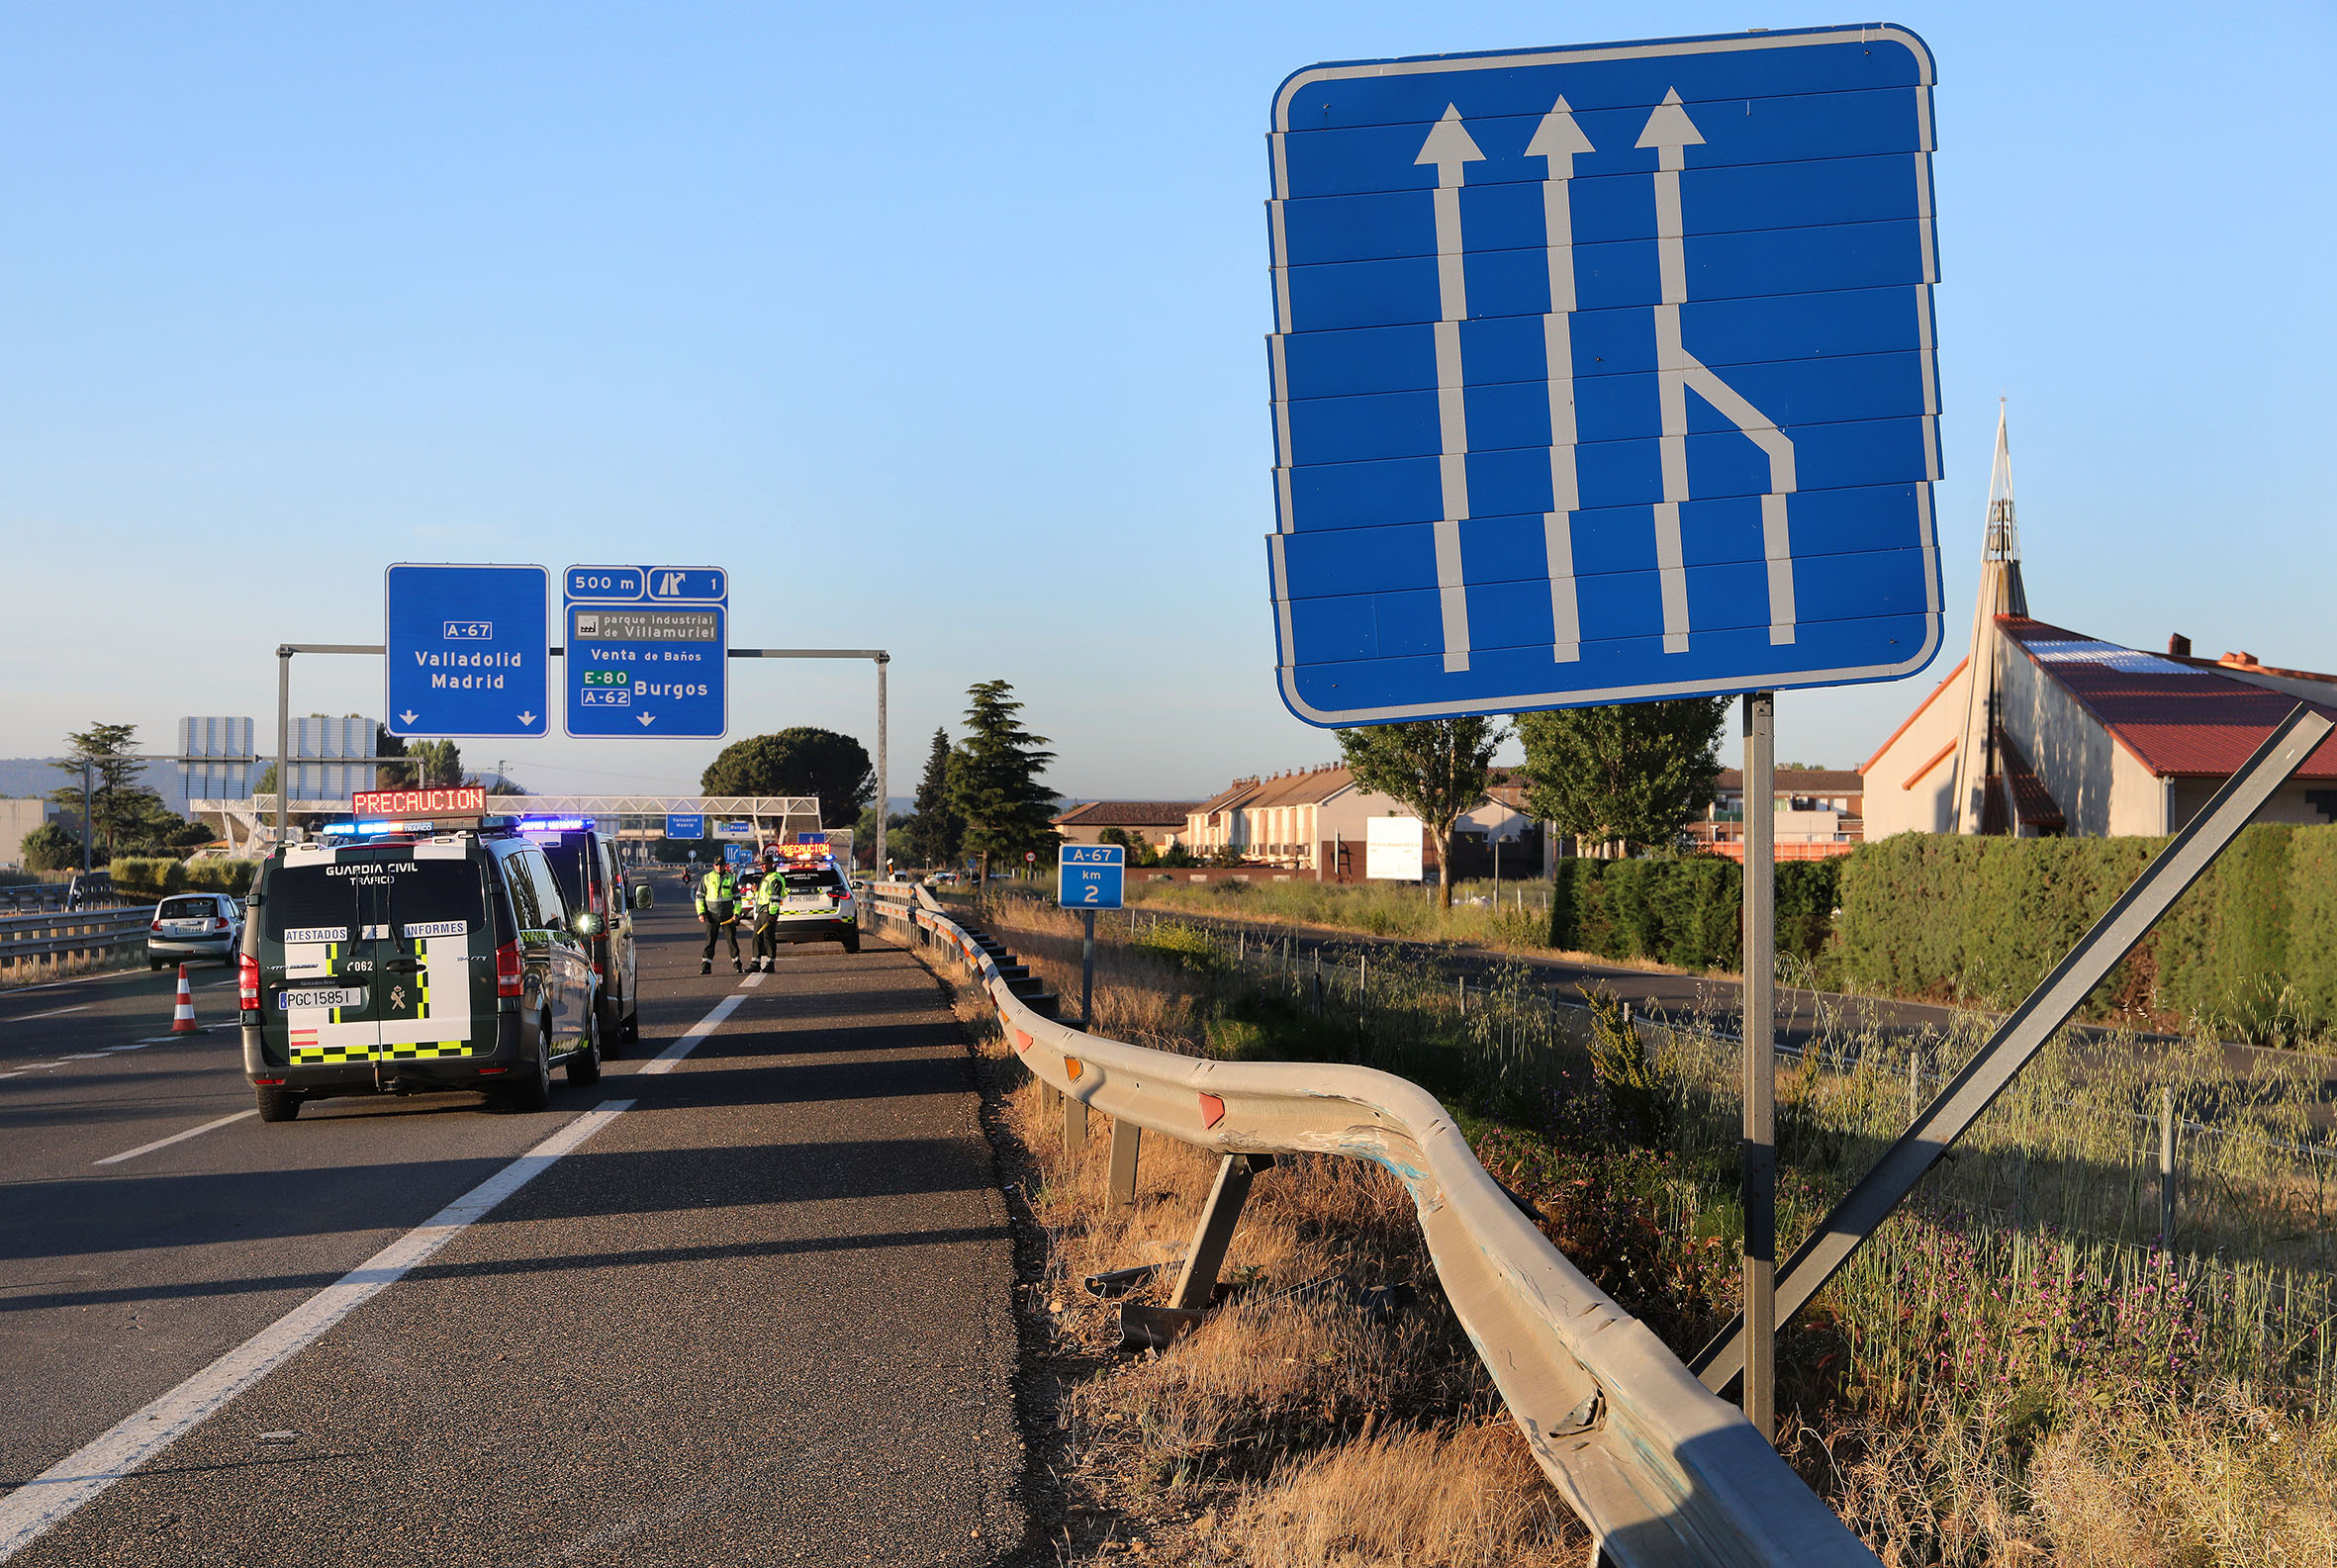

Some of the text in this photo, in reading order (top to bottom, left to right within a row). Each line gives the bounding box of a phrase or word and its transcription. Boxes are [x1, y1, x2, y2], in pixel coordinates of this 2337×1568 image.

[575, 576, 634, 590] 500 m
[710, 578, 716, 591] 1
[604, 615, 713, 626] parque industrial
[446, 624, 490, 637] A-67
[604, 625, 714, 638] de Villamuriel
[415, 651, 521, 667] Valladolid
[591, 649, 701, 661] Venta de Baños
[431, 673, 505, 690] Madrid
[584, 672, 627, 685] E-80
[634, 681, 708, 699] Burgos
[585, 691, 627, 703] A-62
[353, 787, 484, 816] PRECAUCION
[779, 844, 830, 854] PRECAUCION
[1073, 848, 1112, 862] A-67
[326, 862, 419, 876] GUARDIA CIVIL
[1082, 870, 1101, 880] km
[1083, 884, 1099, 903] 2
[286, 928, 346, 941] ATESTADOS
[408, 922, 464, 936] INFORMES
[354, 961, 373, 971] 062
